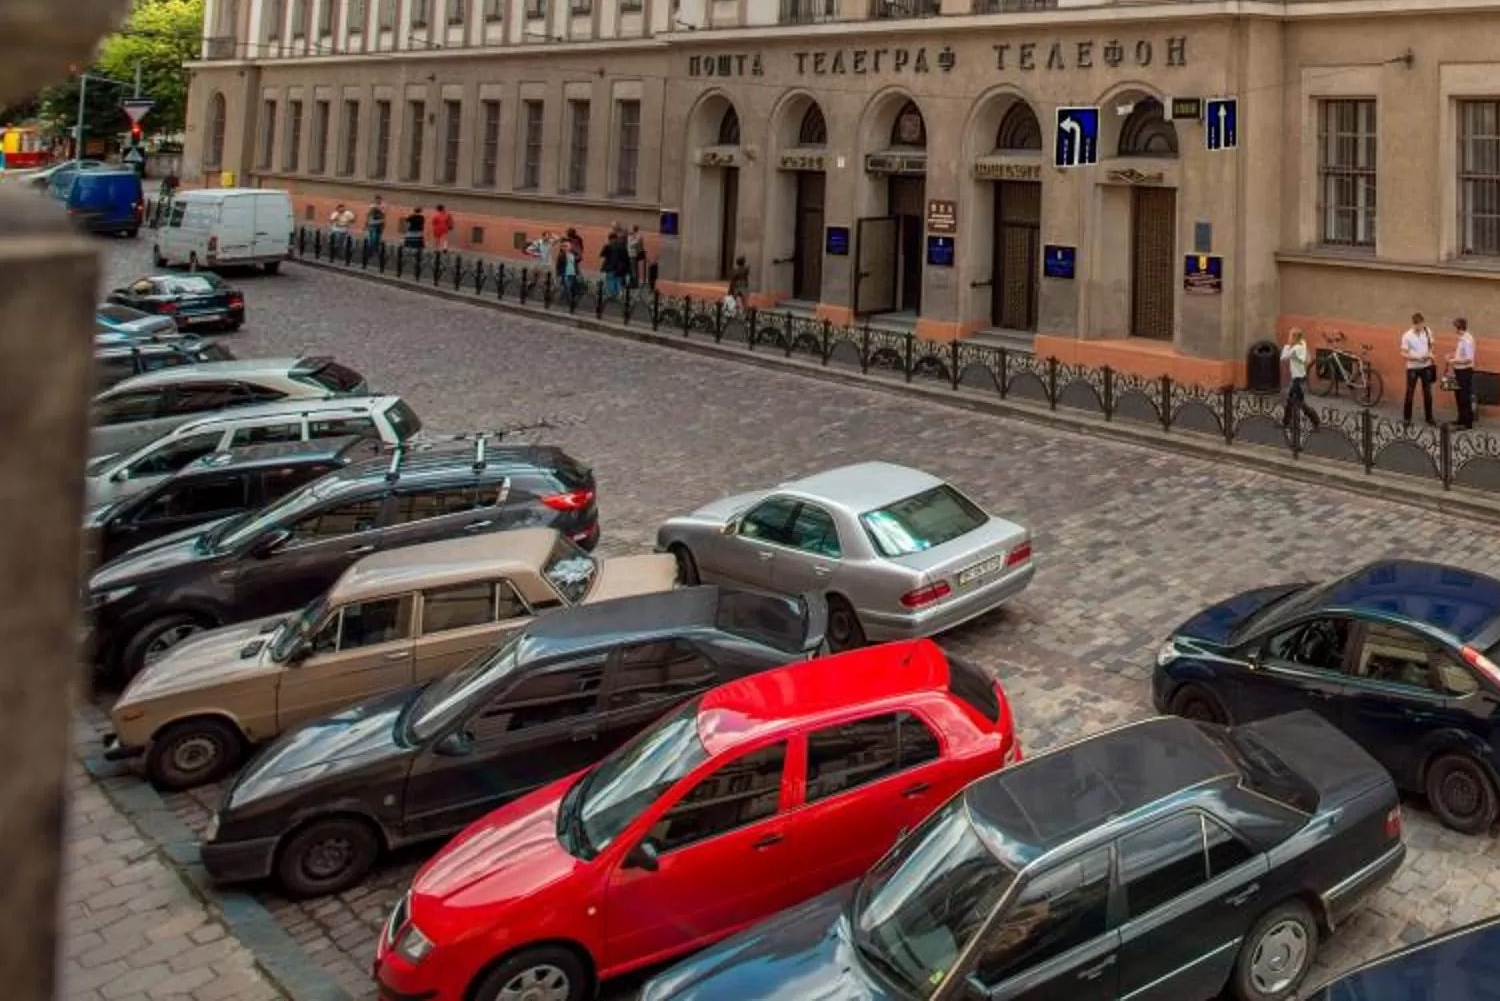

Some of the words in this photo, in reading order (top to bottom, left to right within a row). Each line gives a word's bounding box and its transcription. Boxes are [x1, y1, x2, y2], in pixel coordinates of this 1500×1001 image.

[688, 51, 765, 77] ПОШТА
[794, 46, 957, 76] ТЕЛЕГРАФ
[992, 35, 1188, 71] ТЕЛЕФОН
